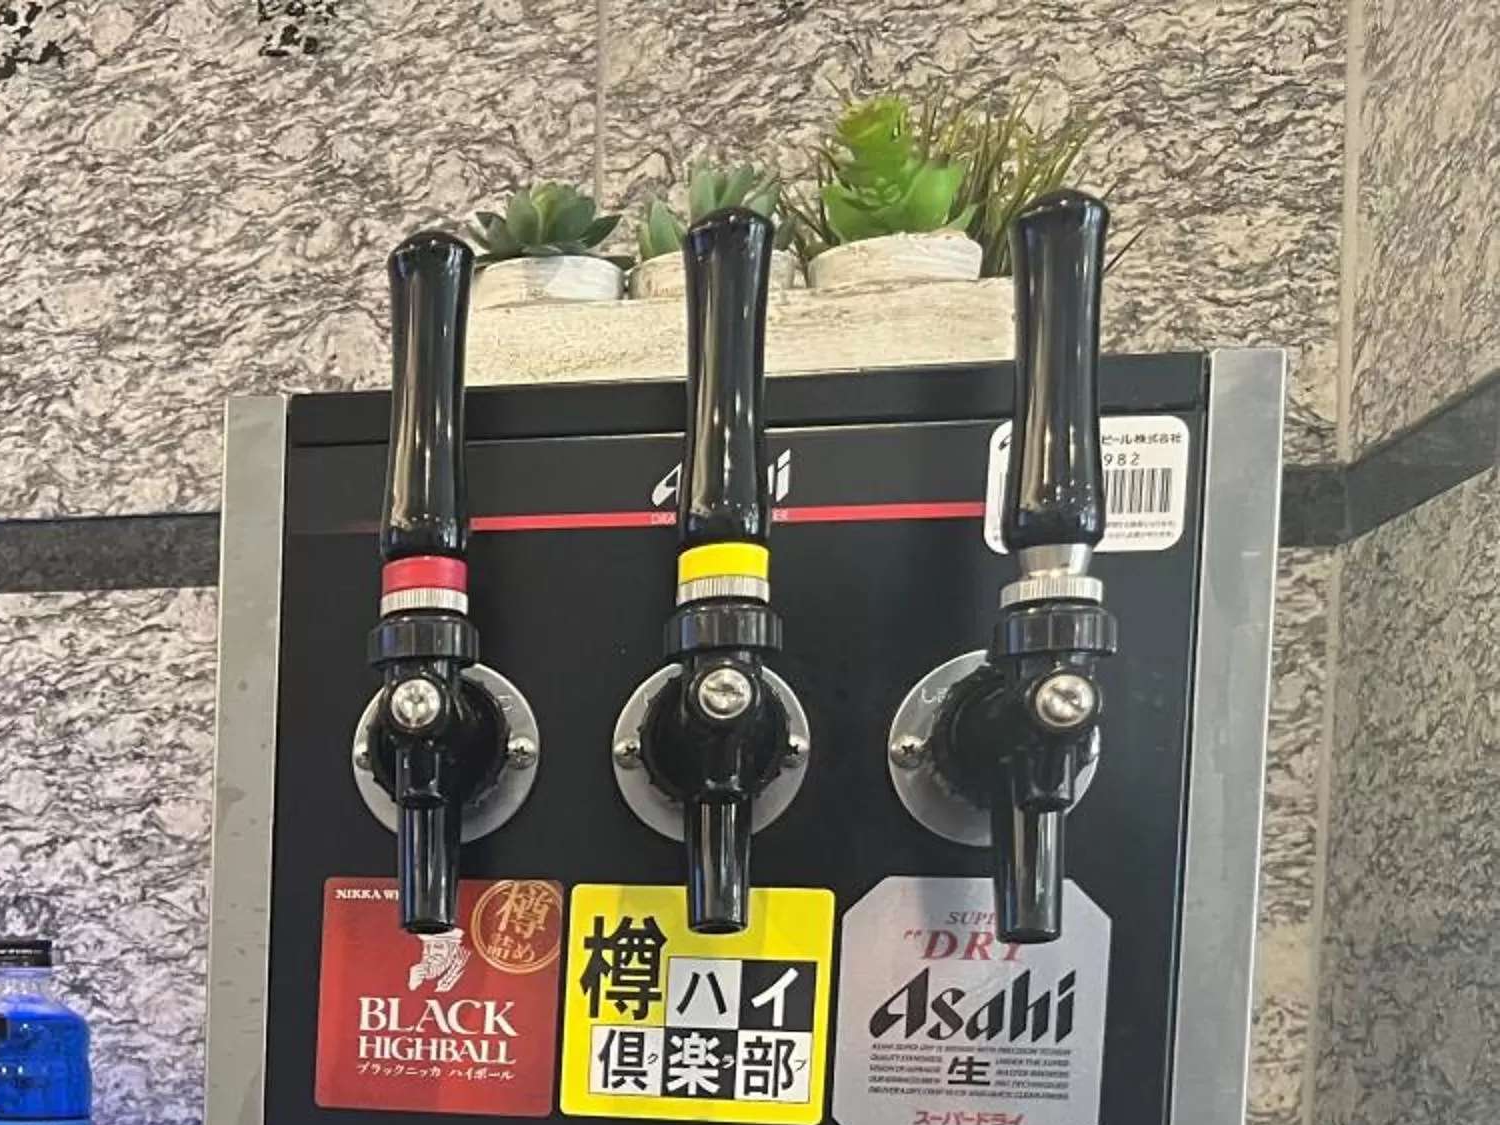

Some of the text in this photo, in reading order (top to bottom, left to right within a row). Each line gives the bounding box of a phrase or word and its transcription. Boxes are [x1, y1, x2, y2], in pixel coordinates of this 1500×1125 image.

[1101, 433, 1182, 445] ビール株式会社
[336, 888, 382, 901] NIKKA
[945, 911, 996, 925] SUP
[358, 996, 520, 1037] BLACK
[869, 967, 1077, 1044] Asahi
[358, 1035, 517, 1065] HIGHBALL
[598, 1029, 797, 1099] 倶楽部
[356, 1061, 516, 1081] ブラックニッカ ハイボール
[947, 1056, 991, 1086] 生
